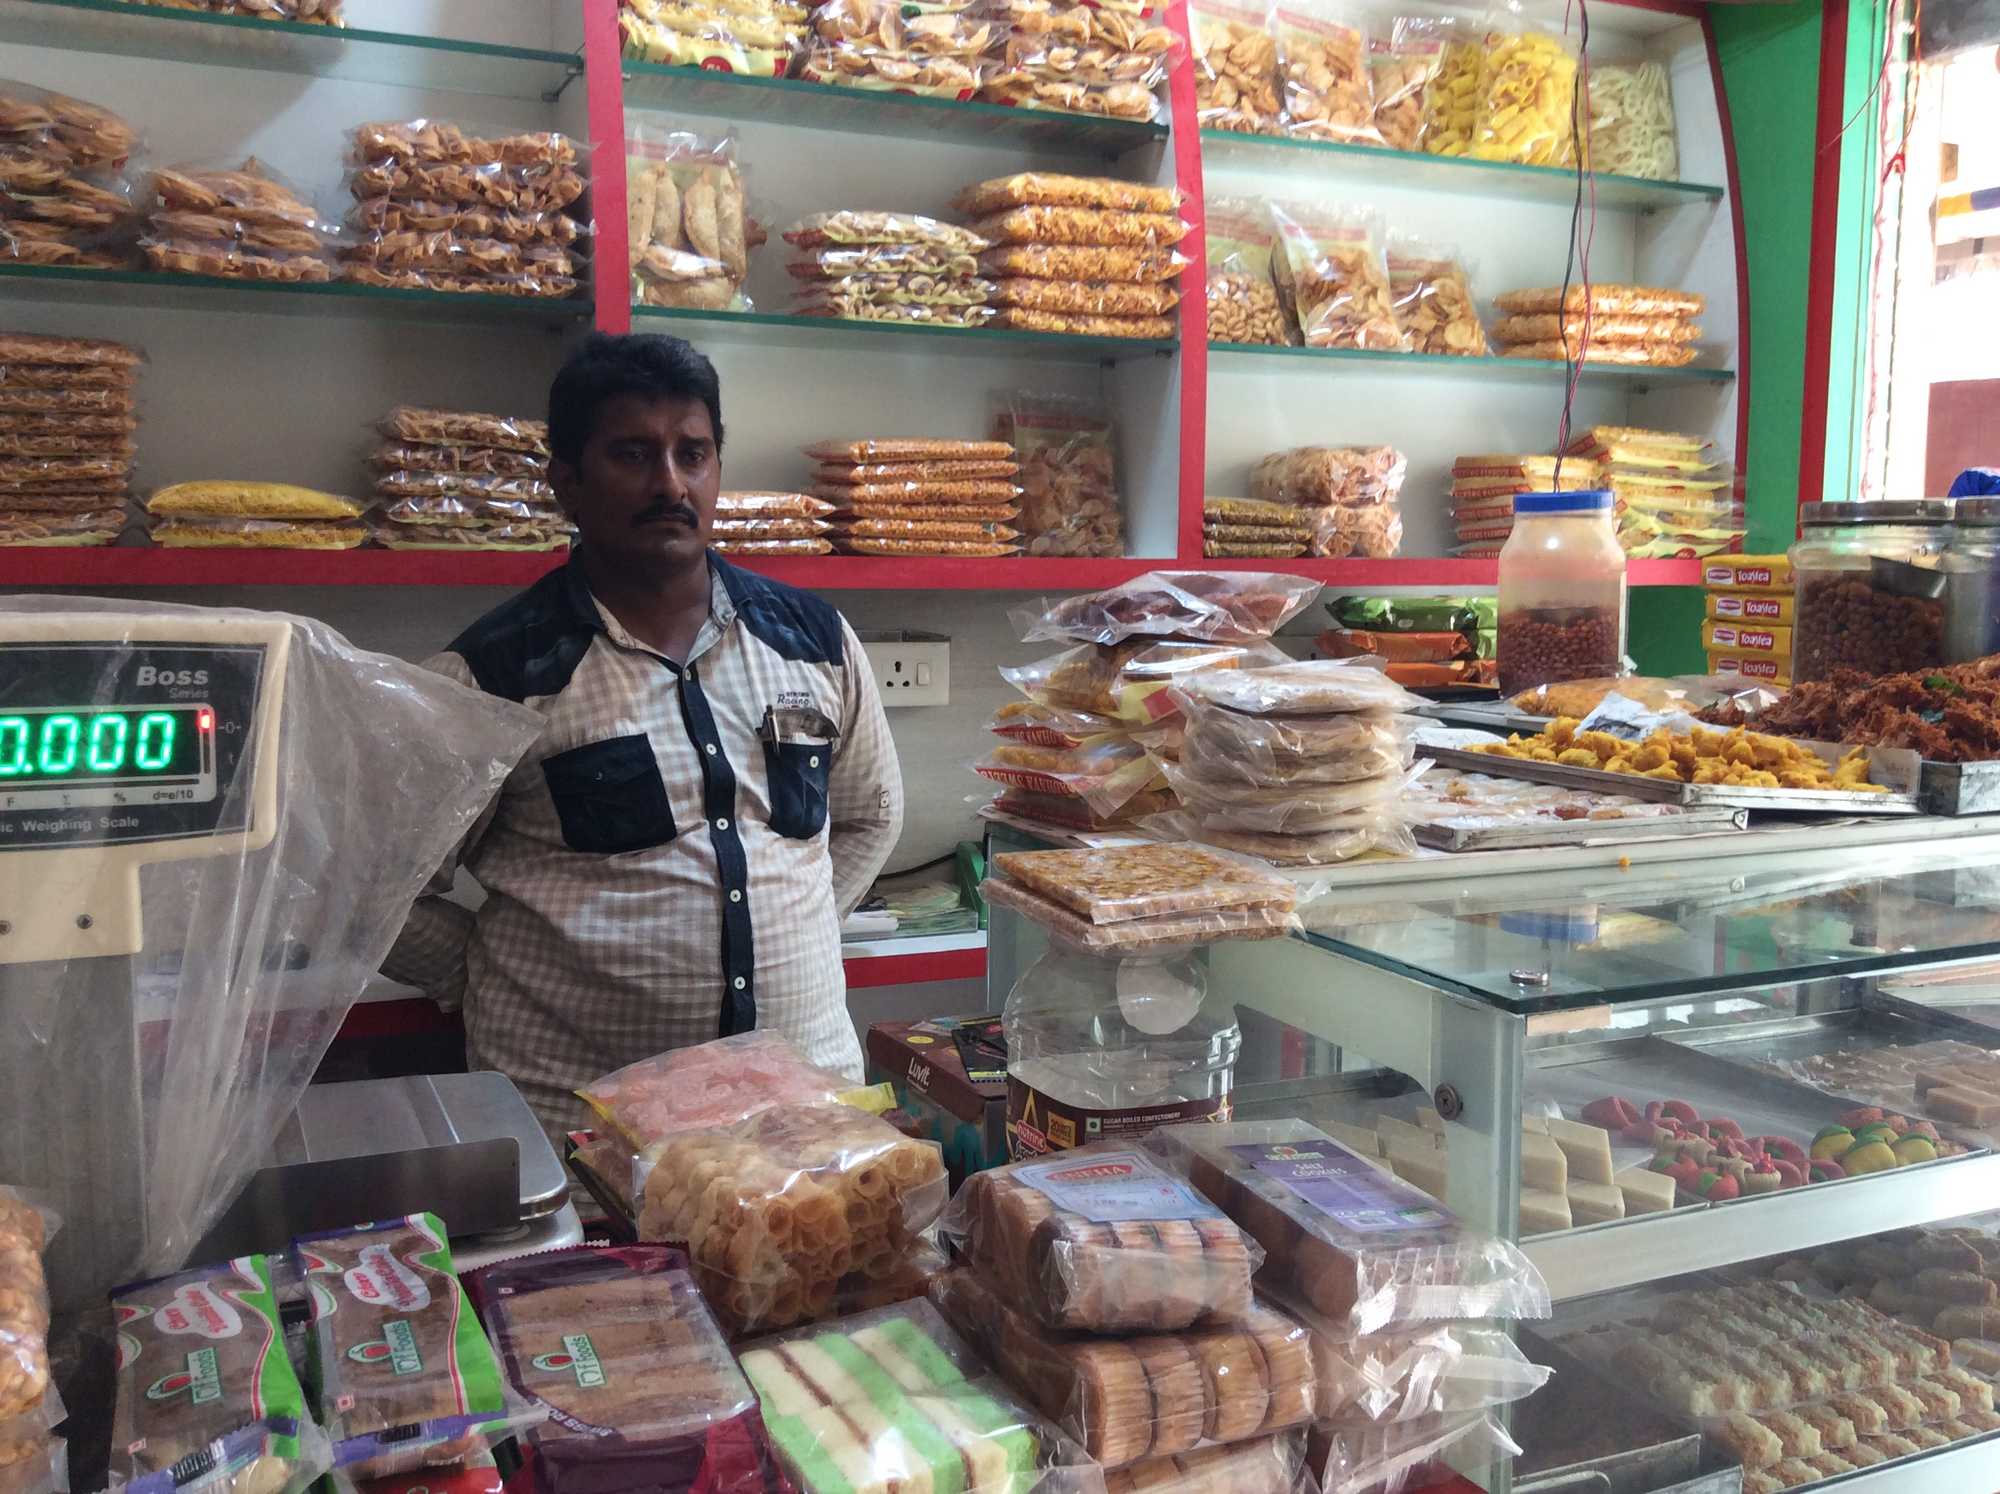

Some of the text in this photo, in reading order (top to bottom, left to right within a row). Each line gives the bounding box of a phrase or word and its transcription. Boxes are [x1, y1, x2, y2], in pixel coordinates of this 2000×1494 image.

[136, 666, 209, 687] Boss
[168, 687, 209, 699] Series
[0, 713, 176, 775] 0.000
[22, 818, 92, 835] Weighing
[99, 815, 140, 829] Scale
